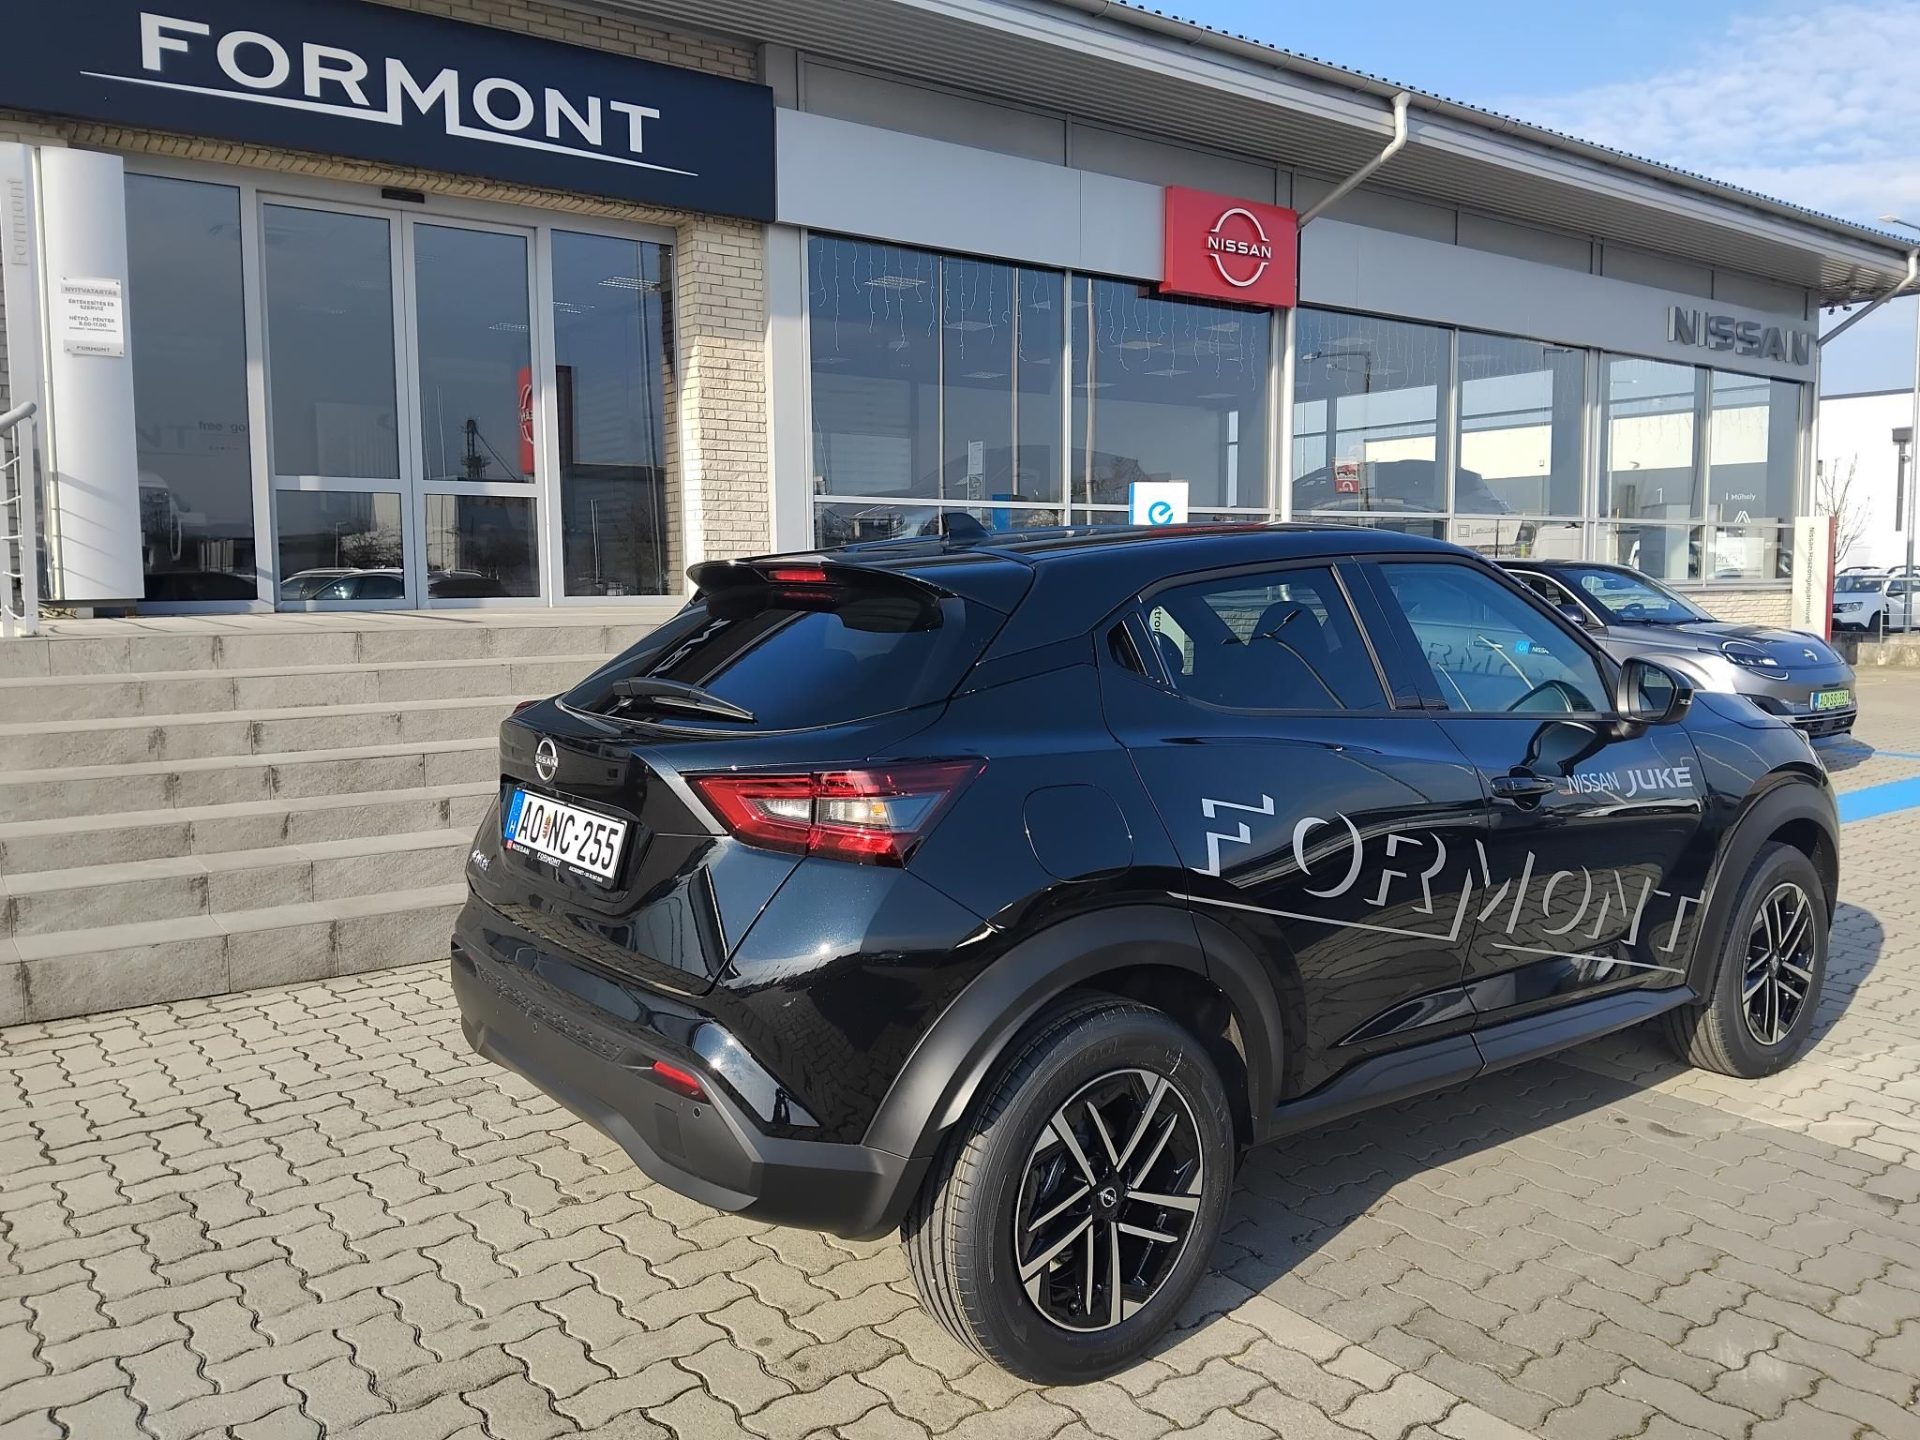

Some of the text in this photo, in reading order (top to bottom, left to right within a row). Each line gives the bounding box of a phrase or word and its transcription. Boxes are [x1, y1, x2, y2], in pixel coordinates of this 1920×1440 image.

[138, 11, 661, 154] FORMONT
[1208, 235, 1272, 259] NISSAN
[1667, 305, 1810, 366] NISSAN
[1566, 766, 1693, 798] NISSAN JUKE
[517, 800, 545, 844] AO
[1189, 794, 1705, 952] FORMONT
